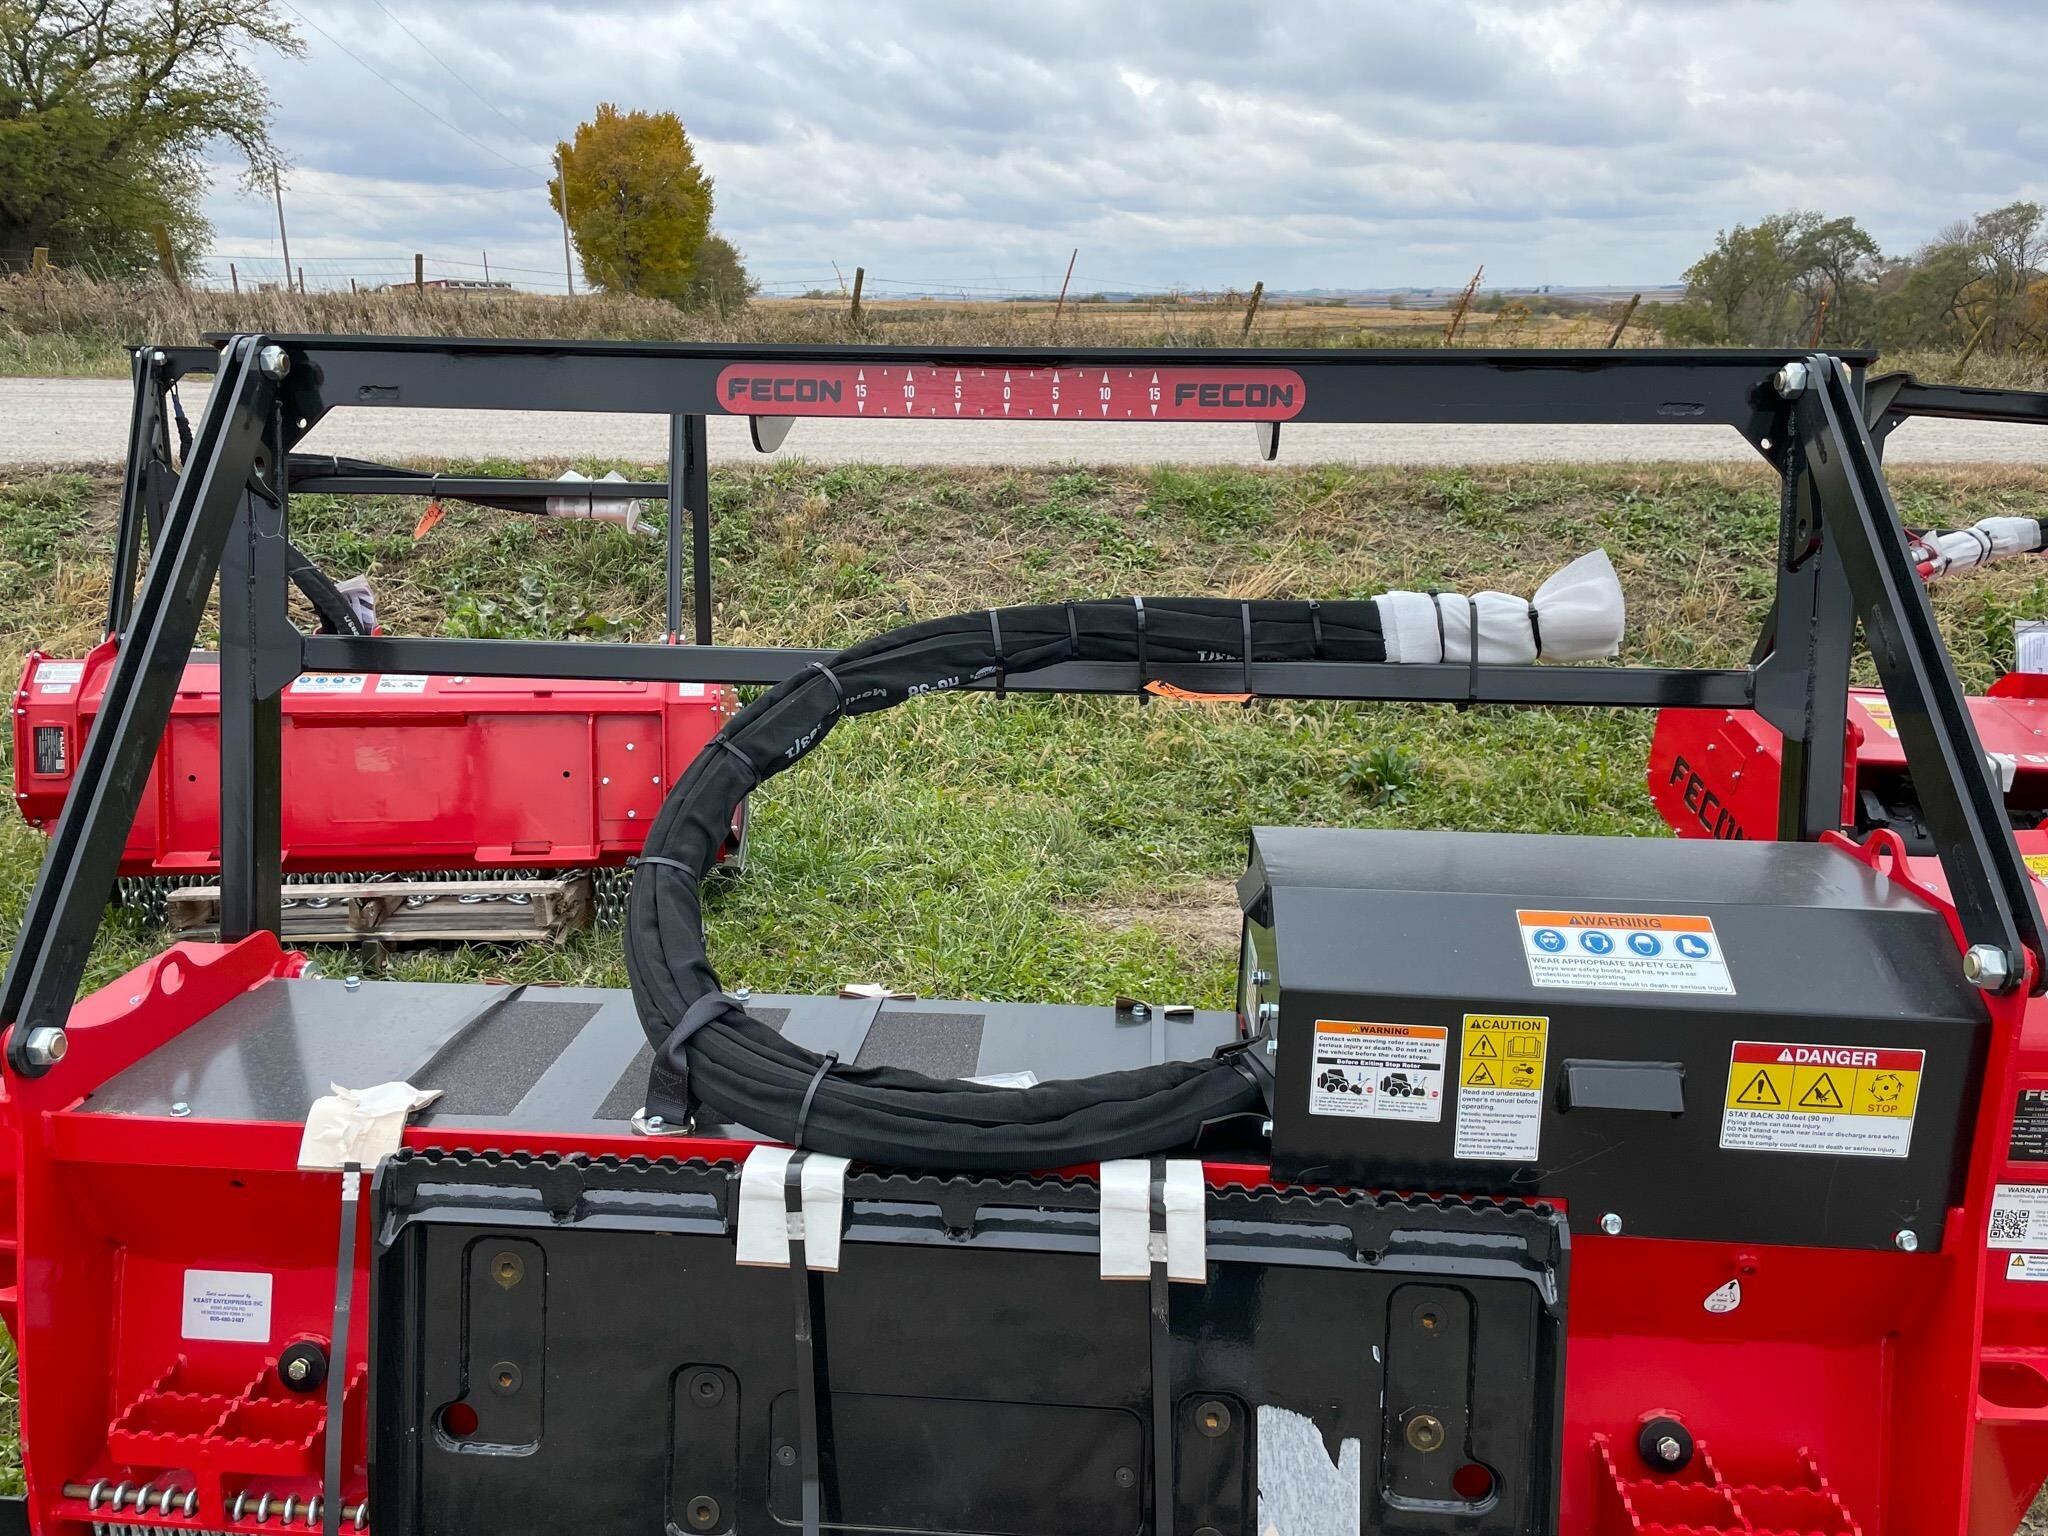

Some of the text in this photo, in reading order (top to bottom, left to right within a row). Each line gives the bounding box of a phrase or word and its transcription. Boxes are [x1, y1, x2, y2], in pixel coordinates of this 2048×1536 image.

[728, 378, 1294, 407] FECON 15 10 5 0 5 10 15 FECON
[1581, 916, 1662, 928] WARNING
[1535, 971, 1571, 979] protection
[1360, 1026, 1409, 1035] WARNING
[1480, 1019, 1542, 1032] CAUTION
[1796, 1049, 1878, 1066] DANGER
[1867, 1104, 1898, 1113] STOP
